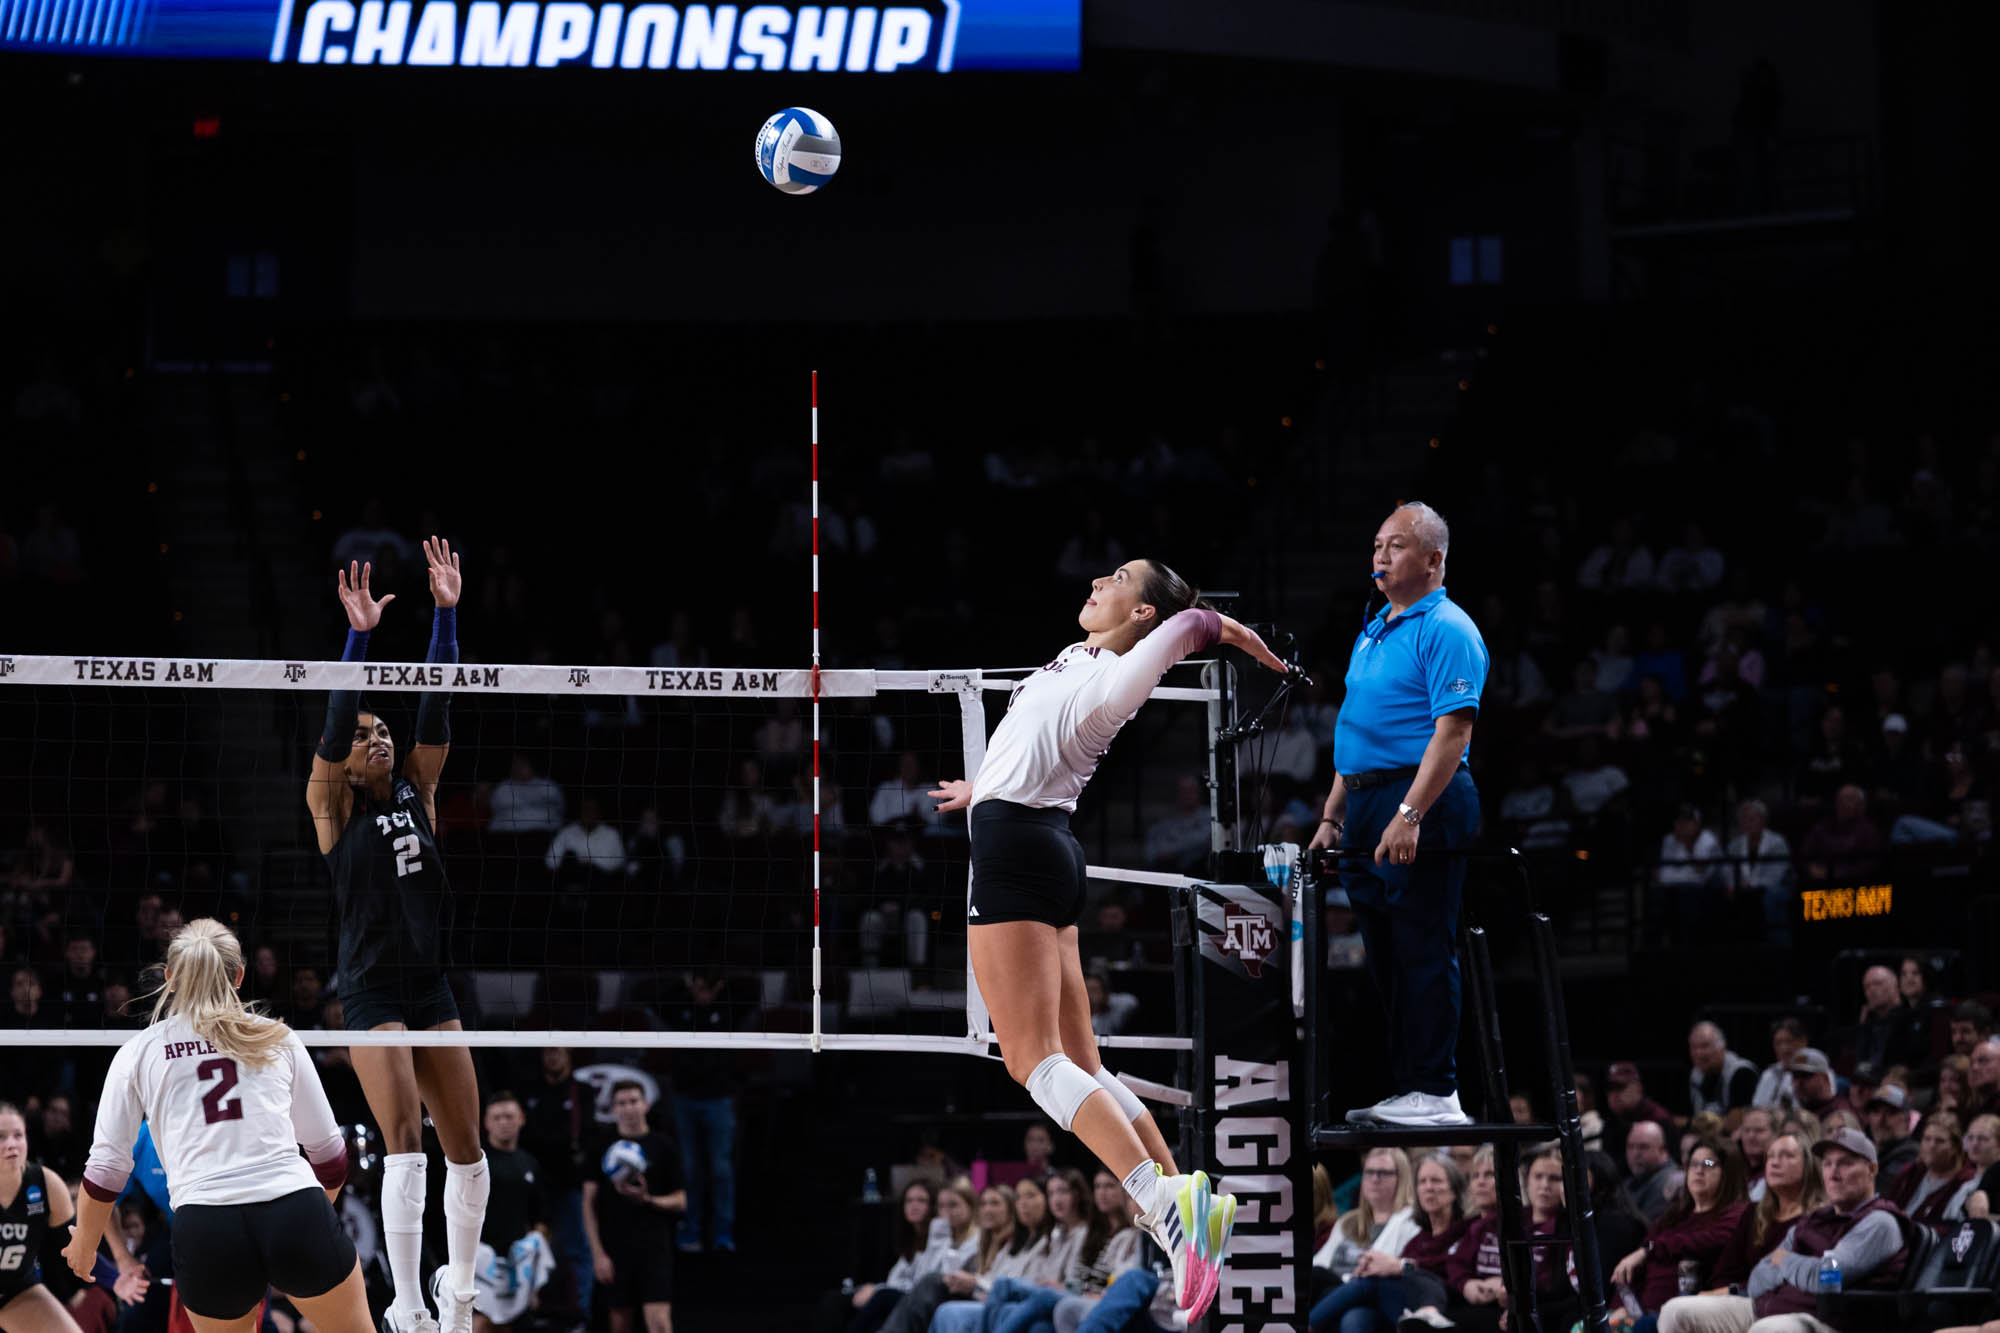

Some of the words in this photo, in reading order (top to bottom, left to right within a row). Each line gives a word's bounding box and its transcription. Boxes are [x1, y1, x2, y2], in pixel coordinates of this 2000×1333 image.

[298, 0, 932, 72] CHAMPIONSHIP
[0, 658, 15, 677] TM
[74, 660, 155, 681] TEXAS
[165, 662, 214, 682] A&M
[363, 665, 443, 686] TEXAS
[452, 667, 500, 687] A&M
[646, 671, 722, 690] TEXAS
[732, 672, 778, 691] A&M
[393, 834, 423, 878] 2
[164, 1040, 218, 1060] APPLE
[197, 1057, 243, 1125] 2
[0, 1223, 28, 1240] CU
[0, 1244, 27, 1271] 6
